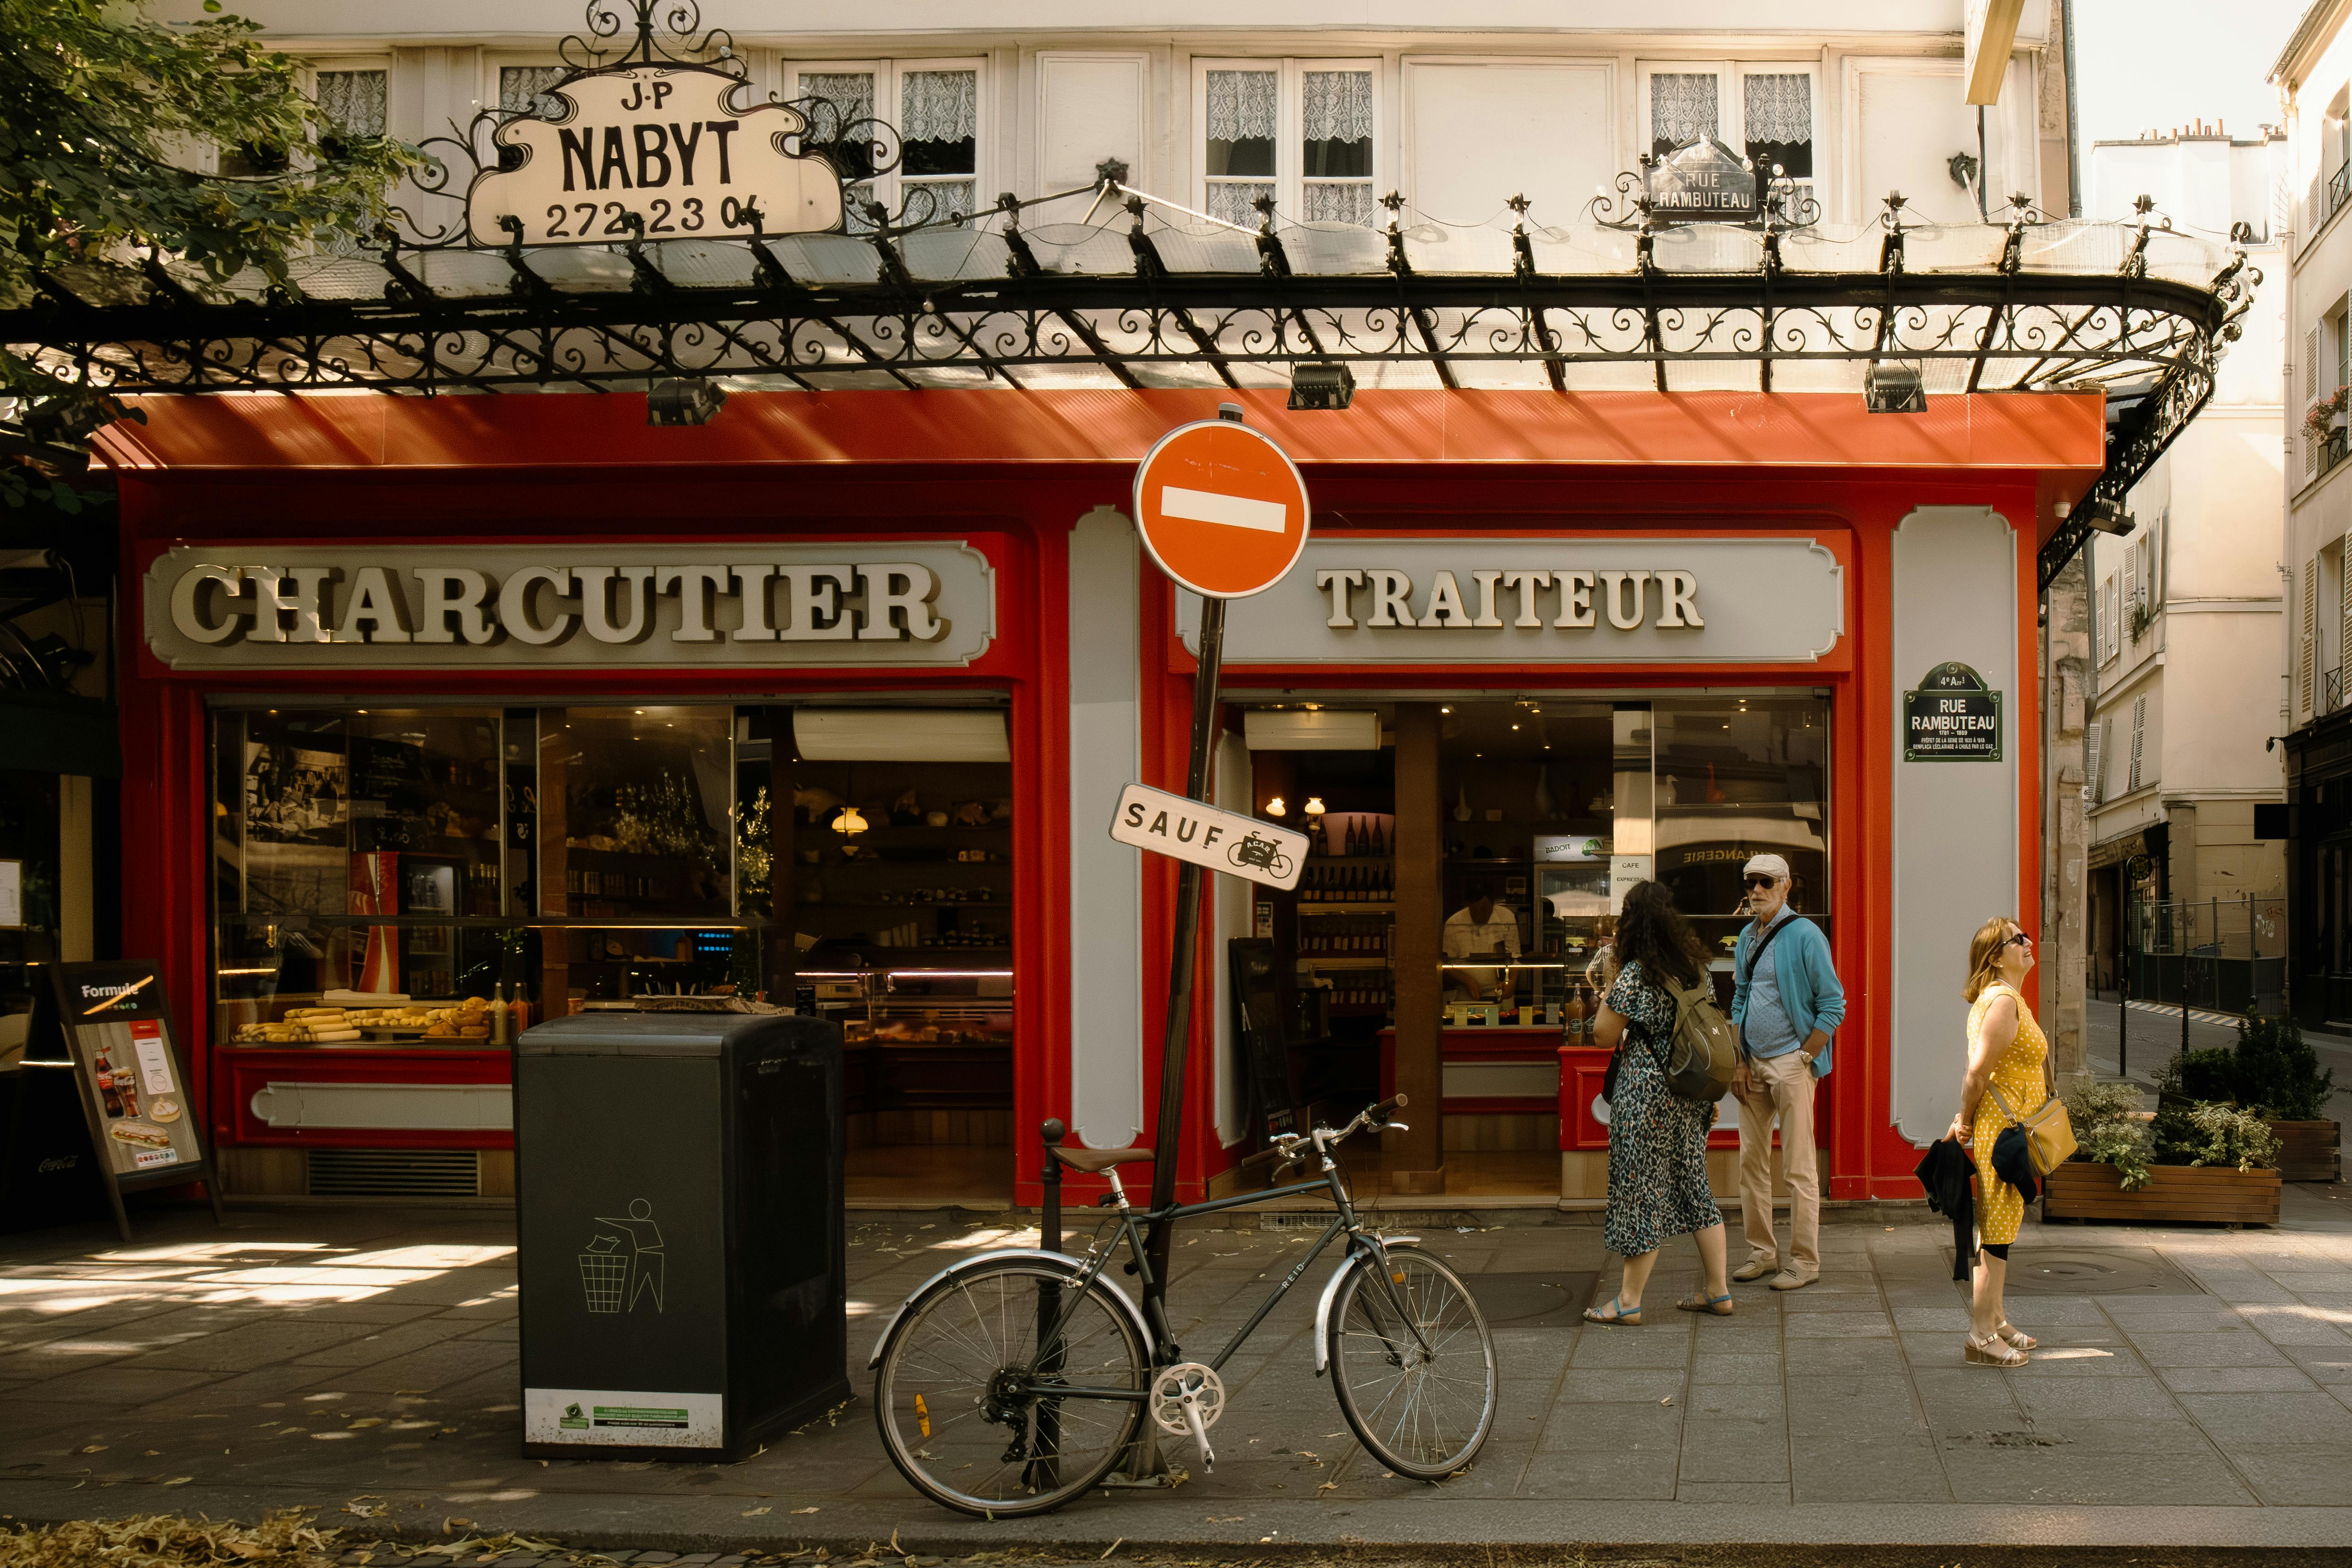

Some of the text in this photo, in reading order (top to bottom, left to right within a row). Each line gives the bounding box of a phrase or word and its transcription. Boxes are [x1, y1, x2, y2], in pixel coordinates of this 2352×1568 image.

[557, 120, 739, 191] NABYT
[1686, 173, 1720, 188] RUE
[1660, 191, 1750, 208] RAMBUTEAU
[546, 201, 627, 238] 272
[649, 197, 704, 232] 23
[170, 562, 951, 646] CHARCUTIER
[1316, 569, 1704, 631] TRAITEUR
[1940, 699, 1966, 713] RUE
[1911, 716, 1994, 730] RAMBUTEAU
[1124, 803, 1223, 849] SAUF
[1546, 844, 1570, 854] BADOIT
[82, 983, 139, 998] Formule
[1282, 1263, 1305, 1289] REID
